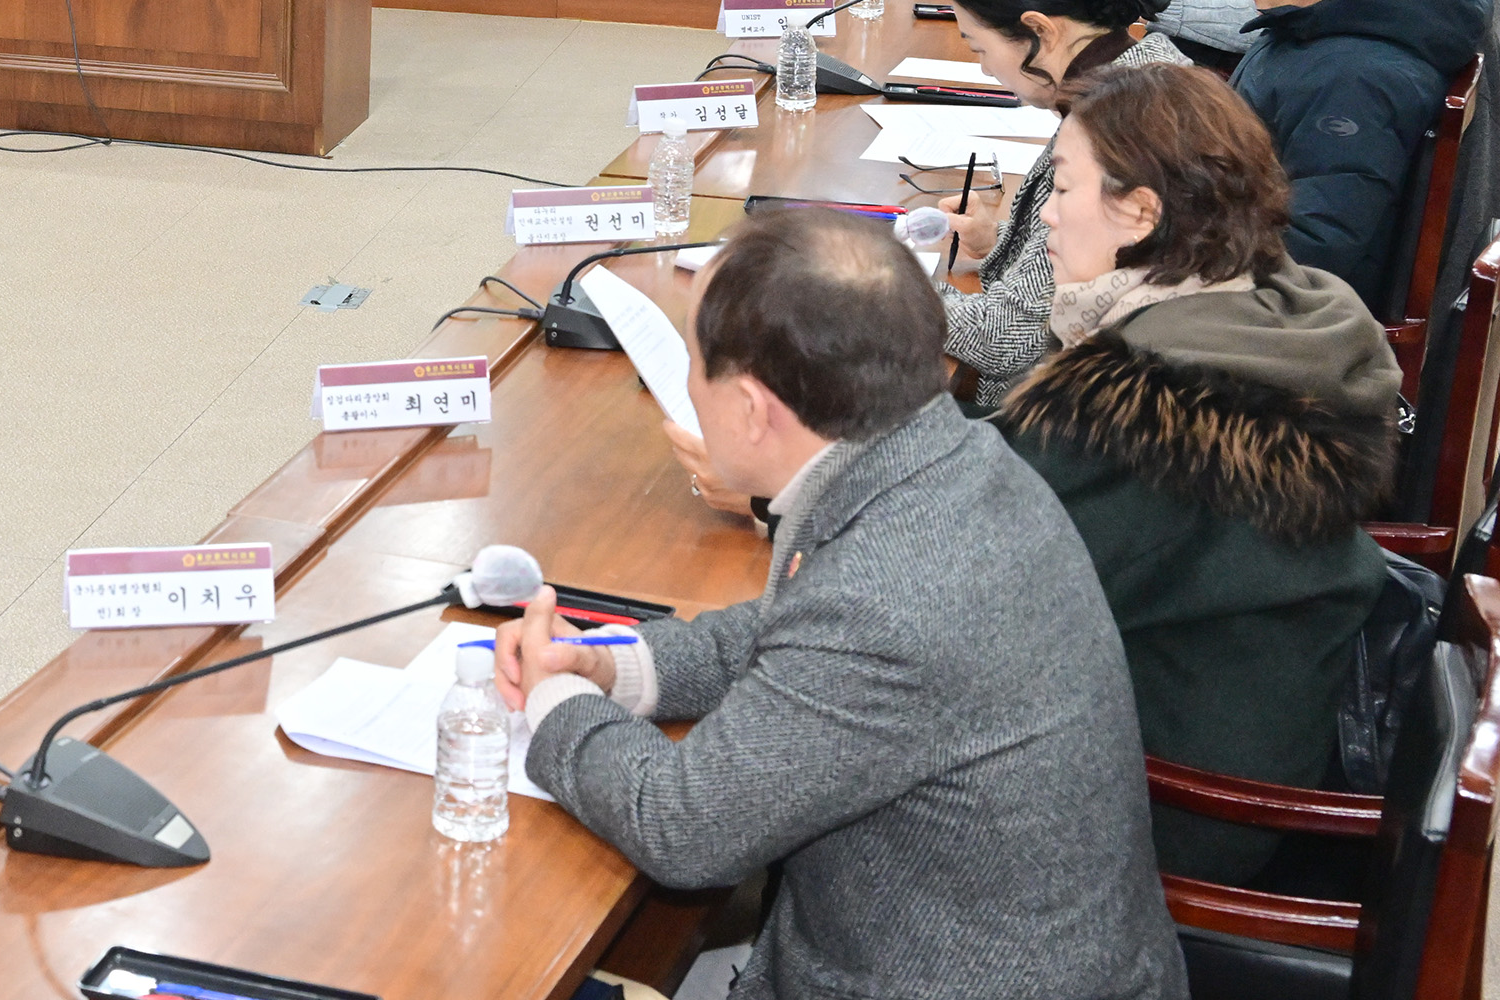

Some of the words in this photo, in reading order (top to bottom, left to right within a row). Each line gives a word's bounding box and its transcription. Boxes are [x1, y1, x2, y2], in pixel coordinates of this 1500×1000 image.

[694, 104, 748, 122] 김성달
[585, 211, 645, 232] 권선미
[405, 390, 477, 415] 최연미
[168, 584, 257, 611] 이치우
